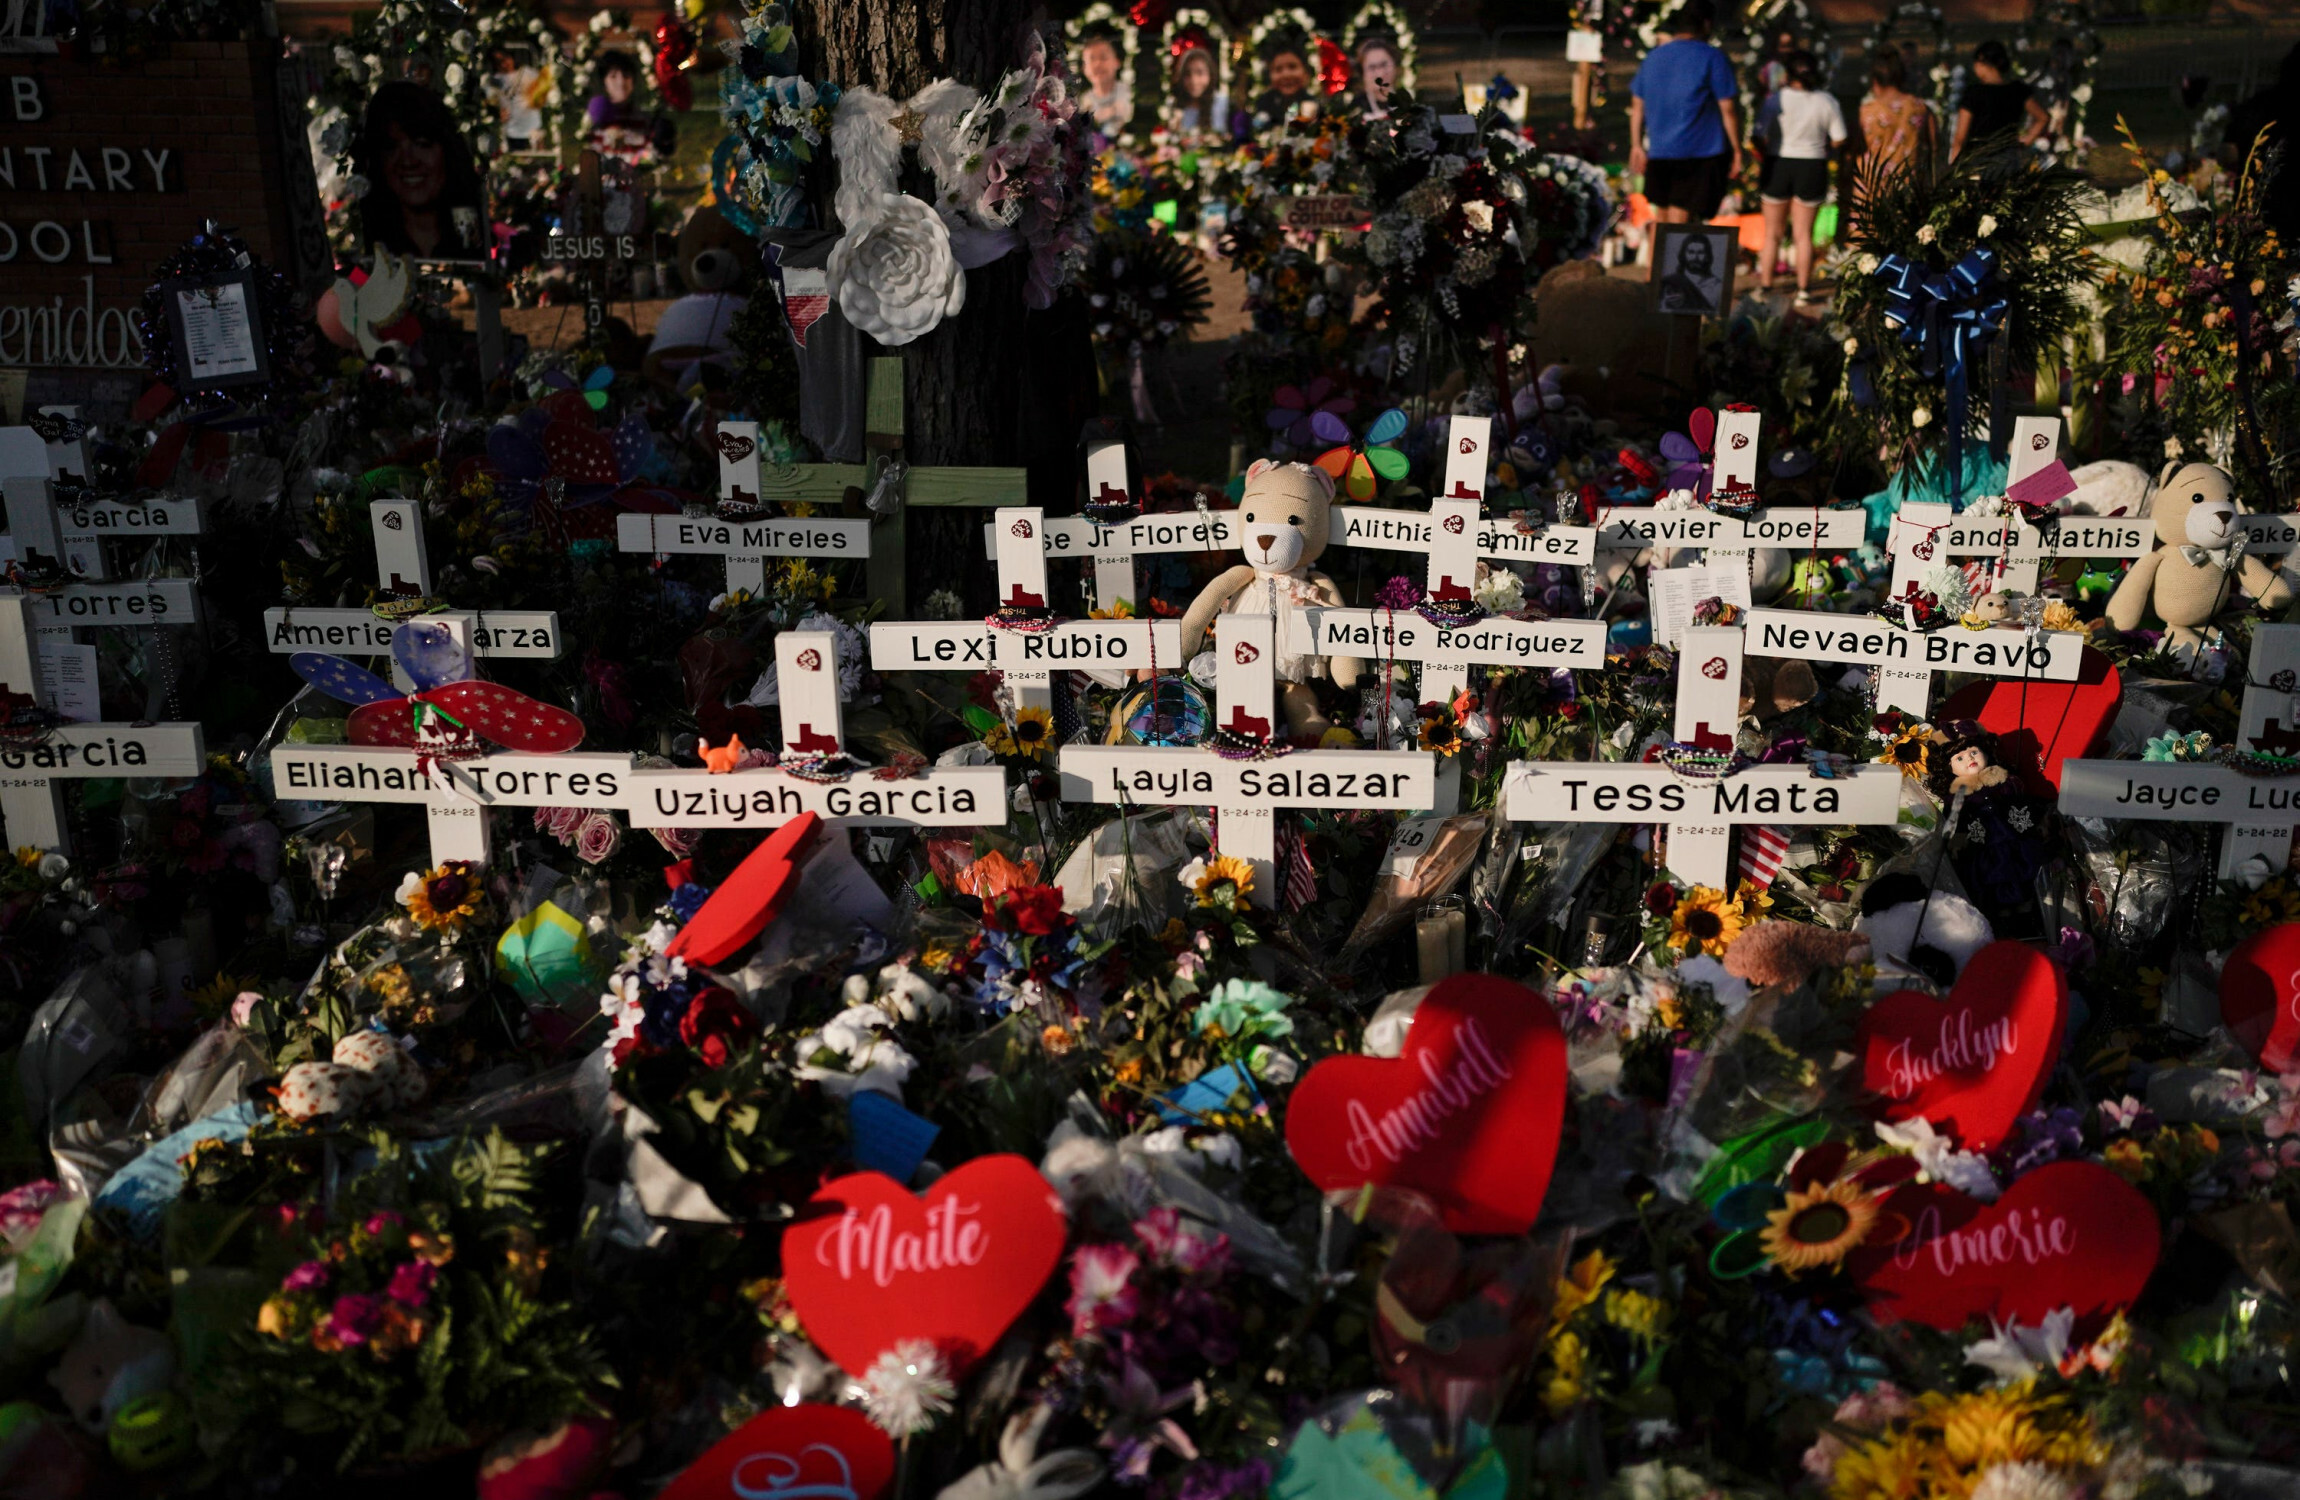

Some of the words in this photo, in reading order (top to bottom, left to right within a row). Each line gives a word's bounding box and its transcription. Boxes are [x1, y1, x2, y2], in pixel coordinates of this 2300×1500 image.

[11, 75, 44, 121] B
[541, 236, 605, 259] JESUS
[616, 235, 635, 258] IS
[723, 438, 744, 448] Eva
[72, 506, 169, 528] Garcia
[1617, 518, 1722, 540] Xavier
[1743, 520, 1830, 541] Lopez
[679, 524, 731, 544] Eva
[743, 527, 847, 549] Mireles
[1087, 525, 1115, 548] Jr
[1131, 522, 1229, 547] Flores
[1477, 529, 1579, 556] amirez
[2038, 527, 2141, 549] Mathis
[728, 556, 760, 564] 5-24-22
[1097, 556, 1130, 564] 5-24-22
[46, 594, 168, 616] Torres
[273, 622, 392, 646] Amerie
[473, 627, 551, 648] arza
[911, 634, 997, 662] Lexi
[1024, 633, 1128, 660] Rubio
[1327, 623, 1415, 647] Maite
[1437, 629, 1584, 657] Rodriguez
[1762, 624, 1908, 659] Nevaeh
[1926, 635, 2052, 670] Bravo
[1008, 672, 1047, 680] 5-24-22
[1426, 663, 1465, 672] 5-24-22
[1885, 672, 1928, 681] 5-24-22
[1, 737, 147, 769] Garcia
[1, 779, 47, 788] 5-24-22
[467, 766, 619, 797] Torres
[1112, 766, 1213, 798] Layla
[1239, 768, 1411, 799] Salazar
[655, 785, 803, 822] Uziyah
[827, 785, 976, 816] Garcia
[1562, 780, 1686, 812] Tess
[1713, 782, 1840, 814] Mata
[2116, 779, 2221, 810] Jayce
[430, 807, 476, 817] 5-24-22
[1222, 809, 1269, 818] 5-24-22
[1677, 827, 1726, 836] 5-24-22
[2236, 828, 2288, 838] 5-24-22
[1885, 1007, 2018, 1100] Jacklyn
[1346, 1014, 1513, 1172] Annabell
[815, 1193, 991, 1288] Maite
[1894, 1203, 2077, 1278] Amerie
